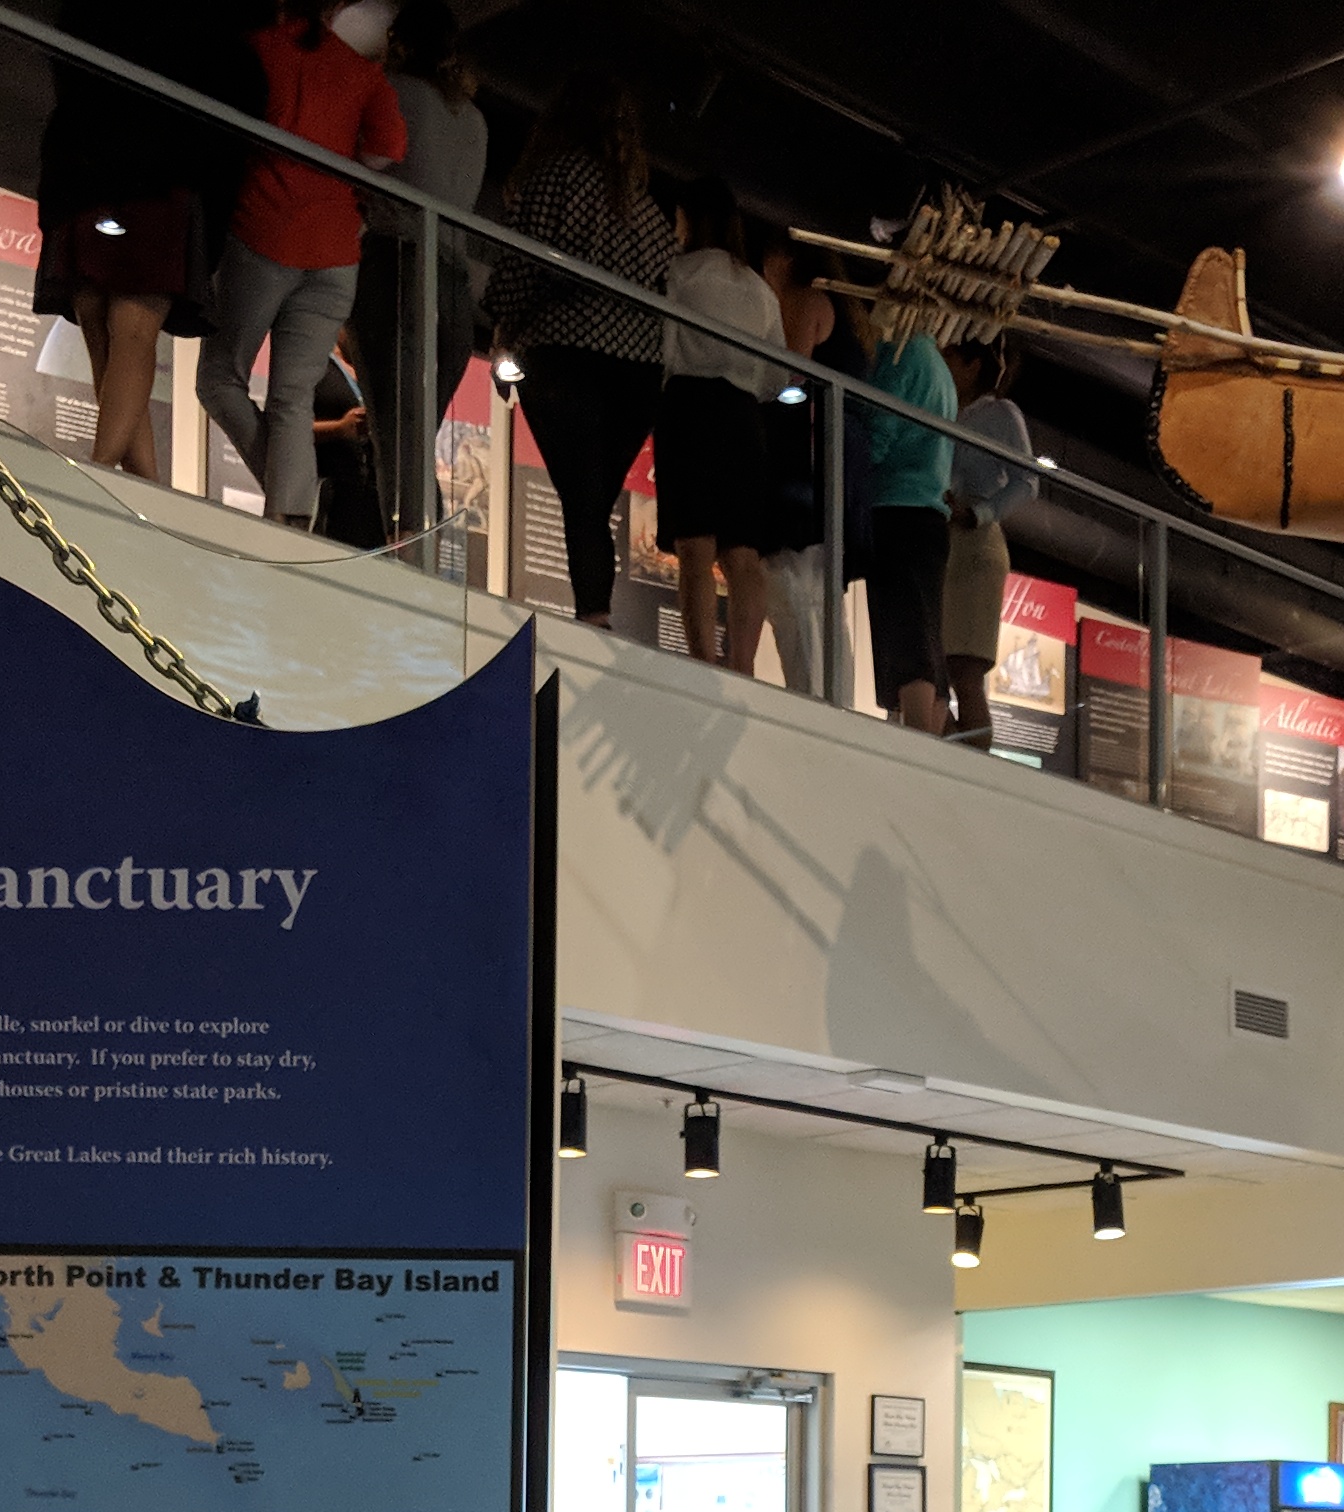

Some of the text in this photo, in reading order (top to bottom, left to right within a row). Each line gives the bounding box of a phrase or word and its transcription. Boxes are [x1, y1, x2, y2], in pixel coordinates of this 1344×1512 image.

[1263, 697, 1341, 739] Atlantic
[29, 1014, 100, 1033] snorkel
[103, 1020, 126, 1032] or
[128, 1015, 170, 1033] dive
[173, 1018, 194, 1033] to
[198, 1016, 270, 1038] explore
[90, 1047, 108, 1065] If
[110, 1052, 145, 1070] you
[150, 1048, 208, 1070] prefer
[211, 1051, 232, 1066] to
[236, 1051, 275, 1071] stay
[278, 1049, 316, 1072] dry,
[66, 1084, 90, 1097] or
[93, 1081, 168, 1102] pristine
[172, 1083, 219, 1099] state
[223, 1082, 282, 1104] parks.
[7, 1144, 61, 1162] Great
[66, 1145, 122, 1163] Lakes
[125, 1146, 162, 1164] and
[166, 1146, 214, 1164] their
[217, 1146, 256, 1164] rich
[260, 1146, 333, 1170] history.
[66, 1266, 147, 1290] Point
[158, 1267, 181, 1290] &
[192, 1267, 325, 1292] Thunder
[334, 1268, 393, 1297] Bay
[403, 1270, 500, 1293] Island
[636, 1243, 683, 1296] EXIT
